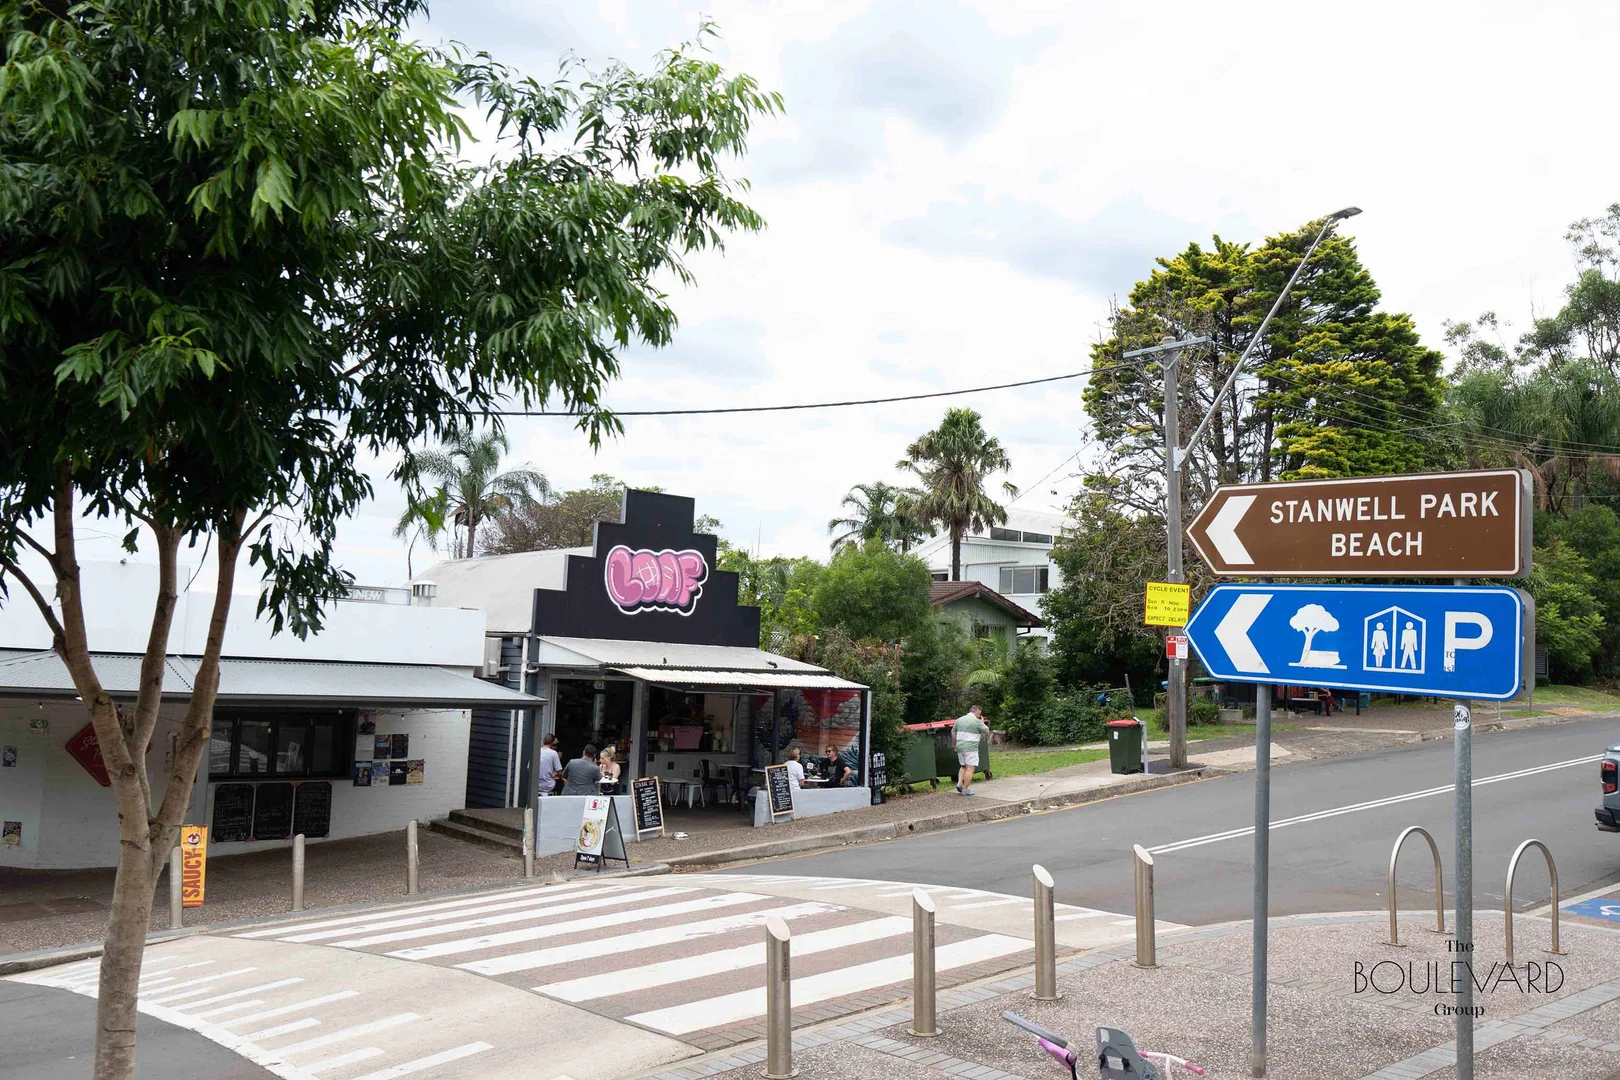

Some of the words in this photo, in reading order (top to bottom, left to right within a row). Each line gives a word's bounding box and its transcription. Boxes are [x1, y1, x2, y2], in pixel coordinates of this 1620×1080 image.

[1270, 496, 1405, 523] STANWELL
[1420, 491, 1499, 518] PARK
[1331, 532, 1423, 556] BEACH
[605, 546, 707, 612] LOAF
[1443, 611, 1494, 672] P
[183, 849, 203, 898] SAUCY
